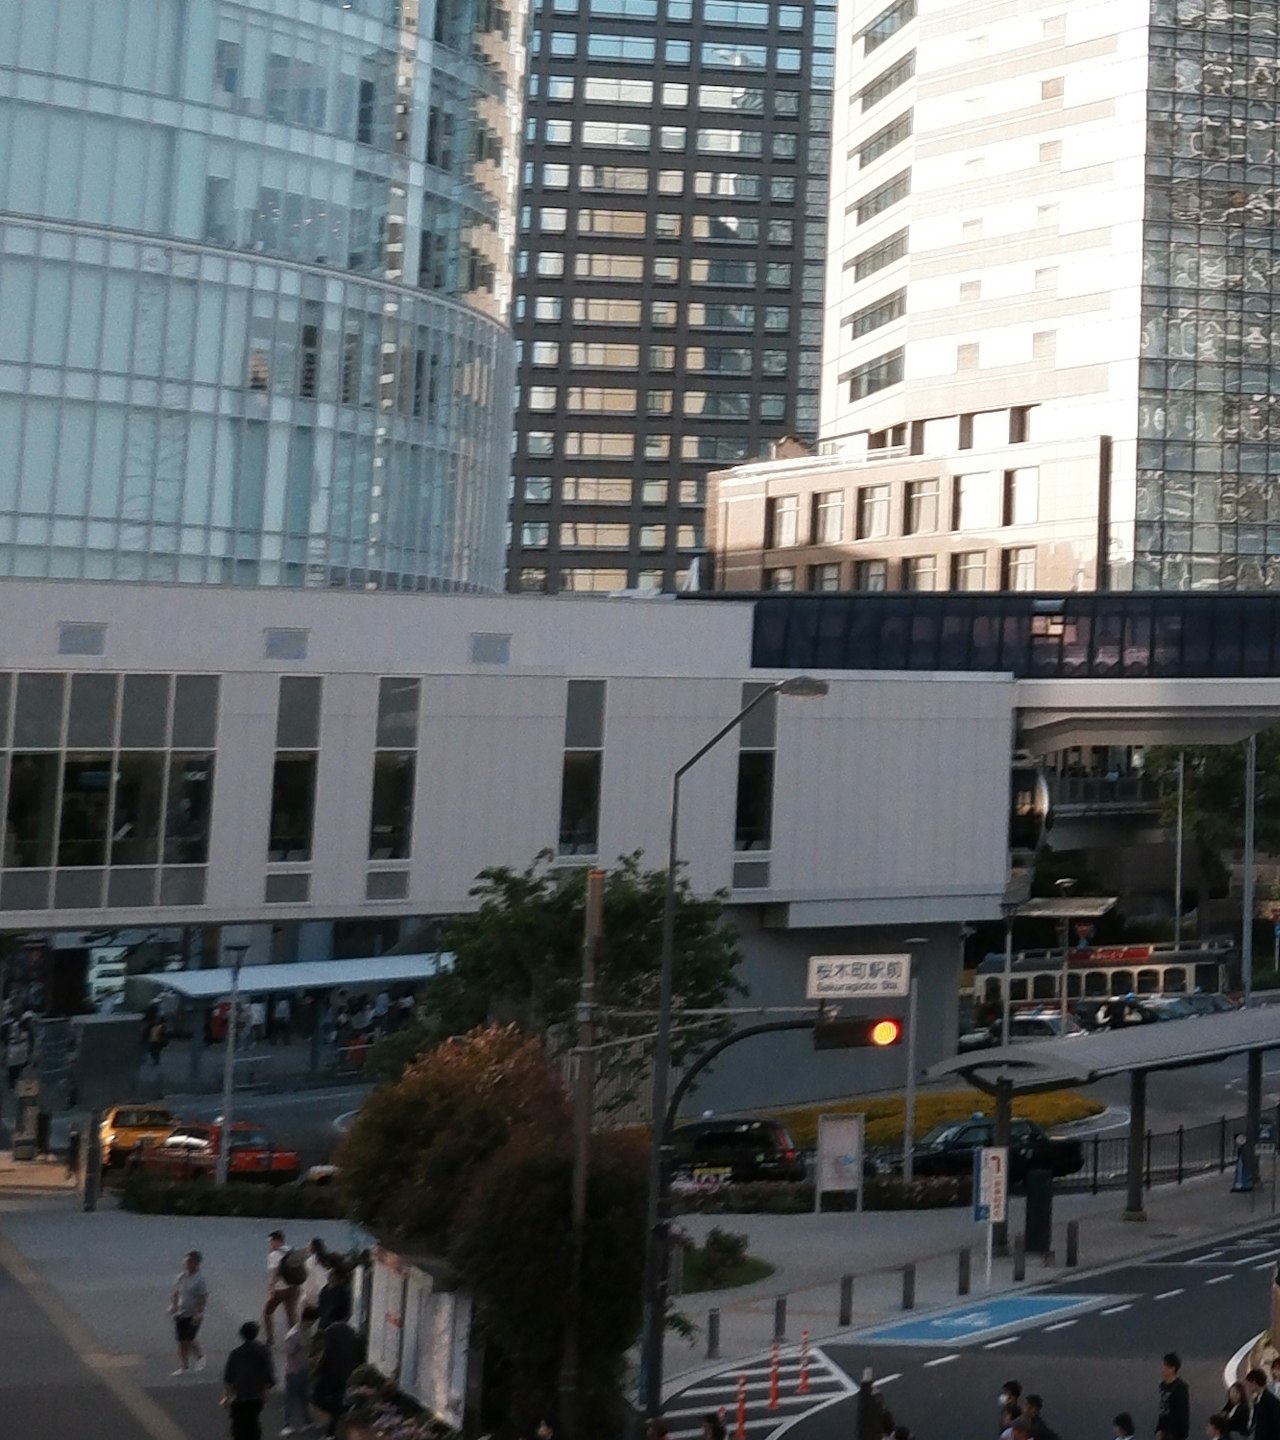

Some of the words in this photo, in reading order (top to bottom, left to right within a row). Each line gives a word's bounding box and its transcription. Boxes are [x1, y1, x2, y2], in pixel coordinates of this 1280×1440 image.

[816, 961, 903, 980] 桜木町駅前
[816, 982, 878, 992] Sakuragicho
